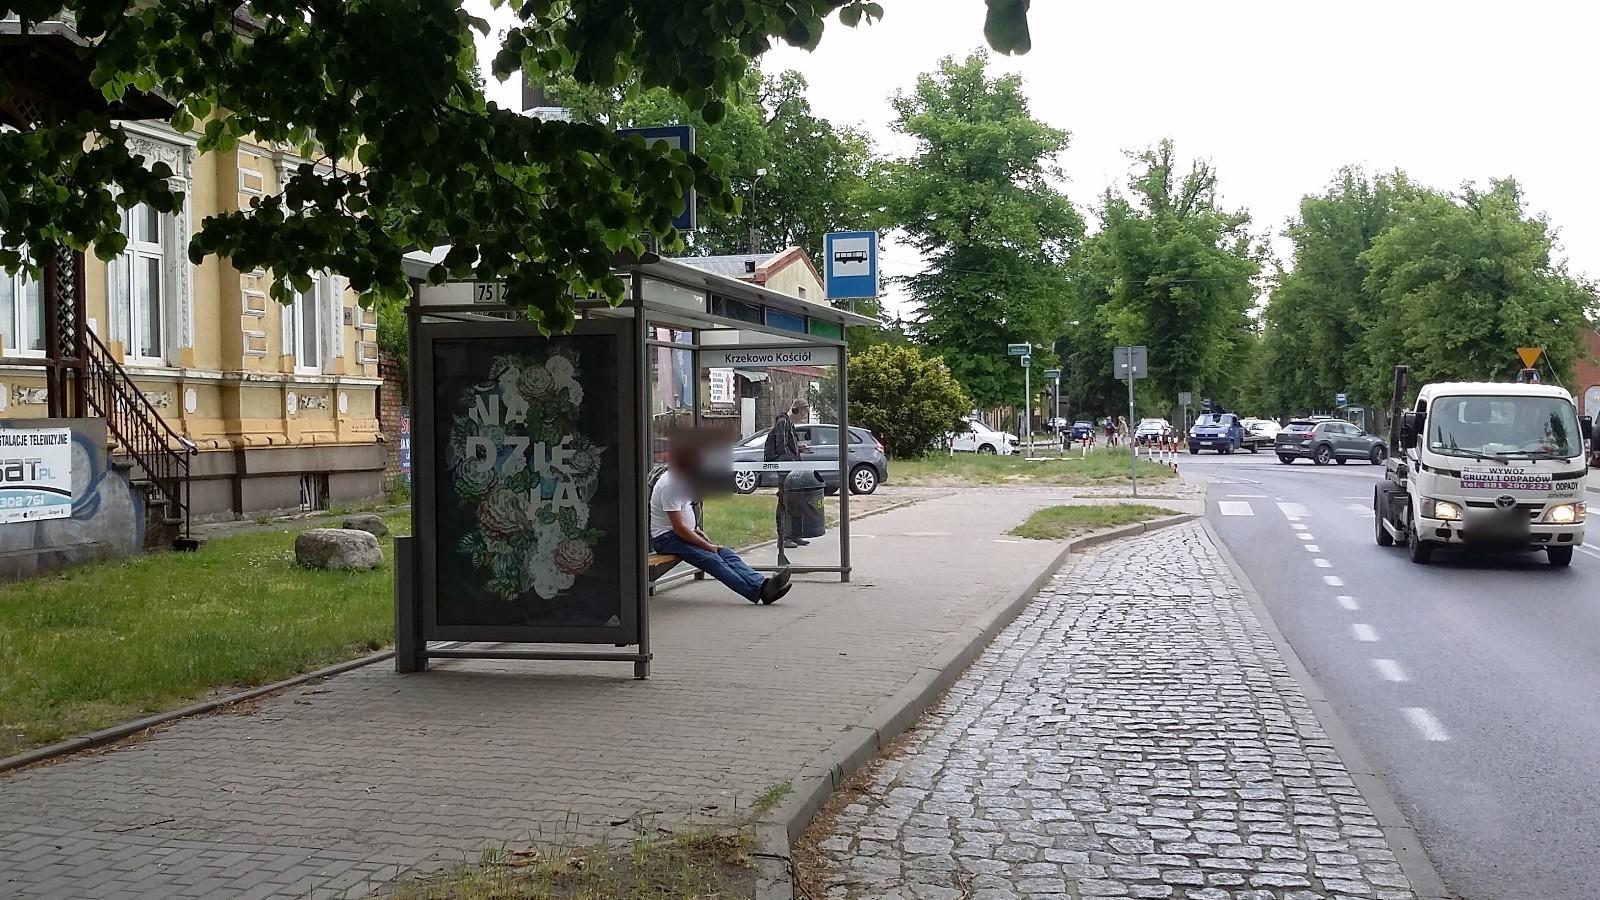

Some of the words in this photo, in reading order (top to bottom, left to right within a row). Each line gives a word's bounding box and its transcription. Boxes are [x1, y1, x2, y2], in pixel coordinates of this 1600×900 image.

[478, 284, 493, 301] 75
[725, 353, 774, 364] Krzekowo
[775, 351, 812, 363] Kościół
[468, 393, 529, 428] NA
[29, 434, 67, 446] TELEWIZYJNE
[1503, 474, 1551, 483] ODPADÓW
[1555, 481, 1579, 491] ODPADY
[0, 496, 23, 508] 302
[26, 494, 44, 506] 761
